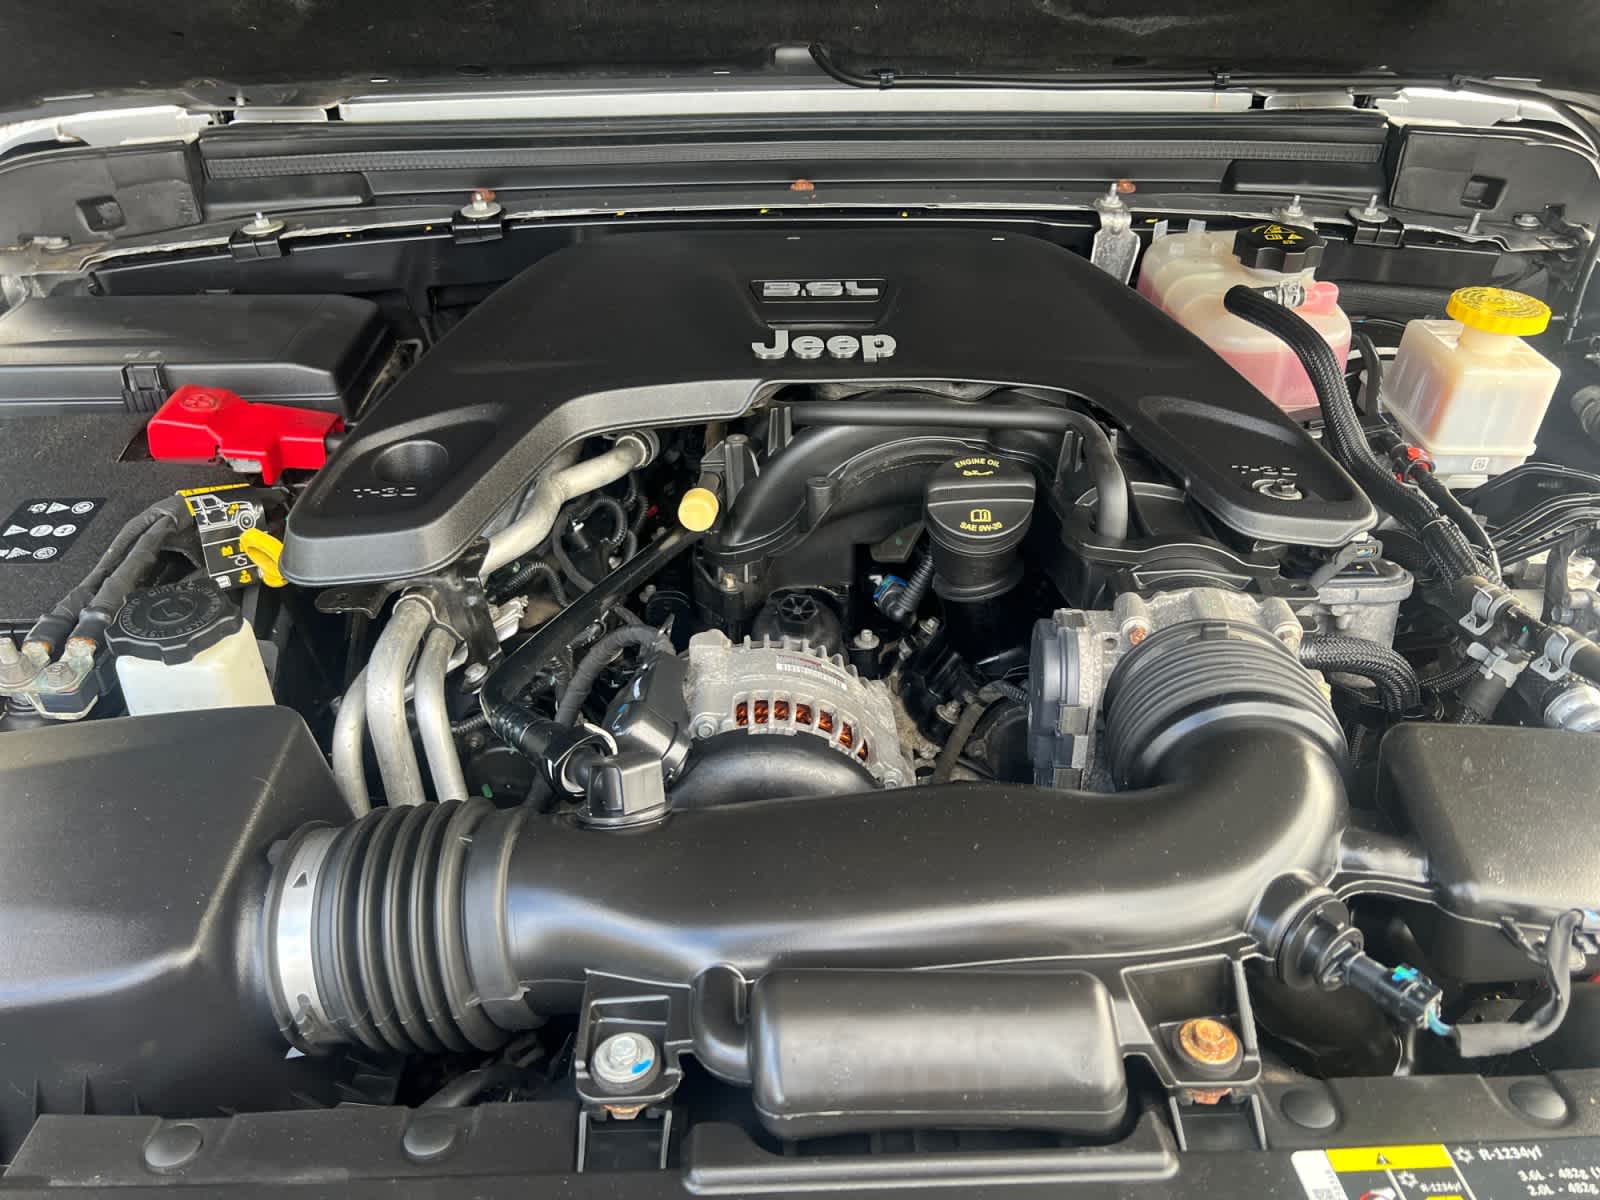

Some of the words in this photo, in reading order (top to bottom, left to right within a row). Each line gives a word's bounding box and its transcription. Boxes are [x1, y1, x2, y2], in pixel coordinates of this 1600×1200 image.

[751, 329, 897, 363] Jeep
[954, 457, 986, 469] ENGINE
[987, 458, 1000, 469] OIL
[959, 521, 978, 532] SAE
